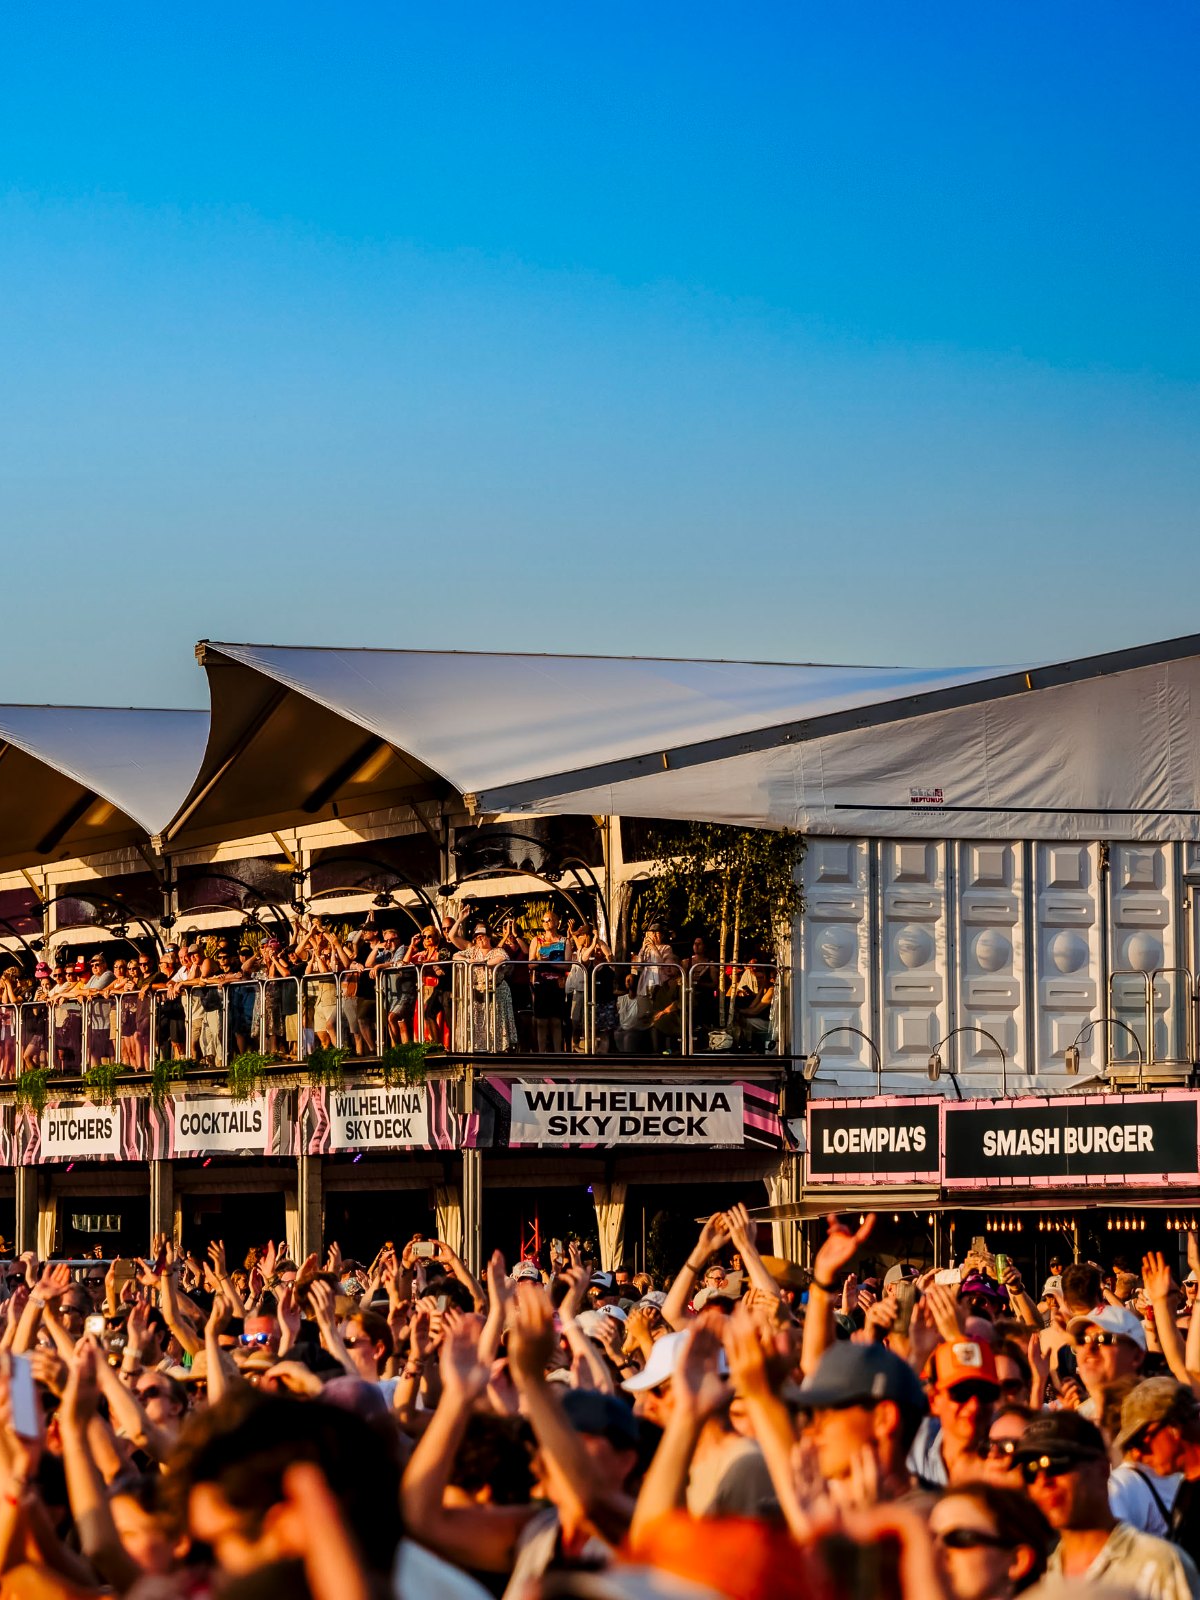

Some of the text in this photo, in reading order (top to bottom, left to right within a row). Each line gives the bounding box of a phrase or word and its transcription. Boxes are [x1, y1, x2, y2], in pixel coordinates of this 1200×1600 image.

[335, 1094, 422, 1117] WILHELMINA
[525, 1091, 731, 1112] WILHELMINA
[48, 1118, 112, 1141] PITCHERS
[180, 1110, 262, 1135] COCKTAILS
[345, 1118, 412, 1140] SKY DECK
[548, 1116, 708, 1136] SKY DECK
[823, 1126, 926, 1154] LOEMPIA'S
[983, 1125, 1154, 1156] SMASH BURGER
